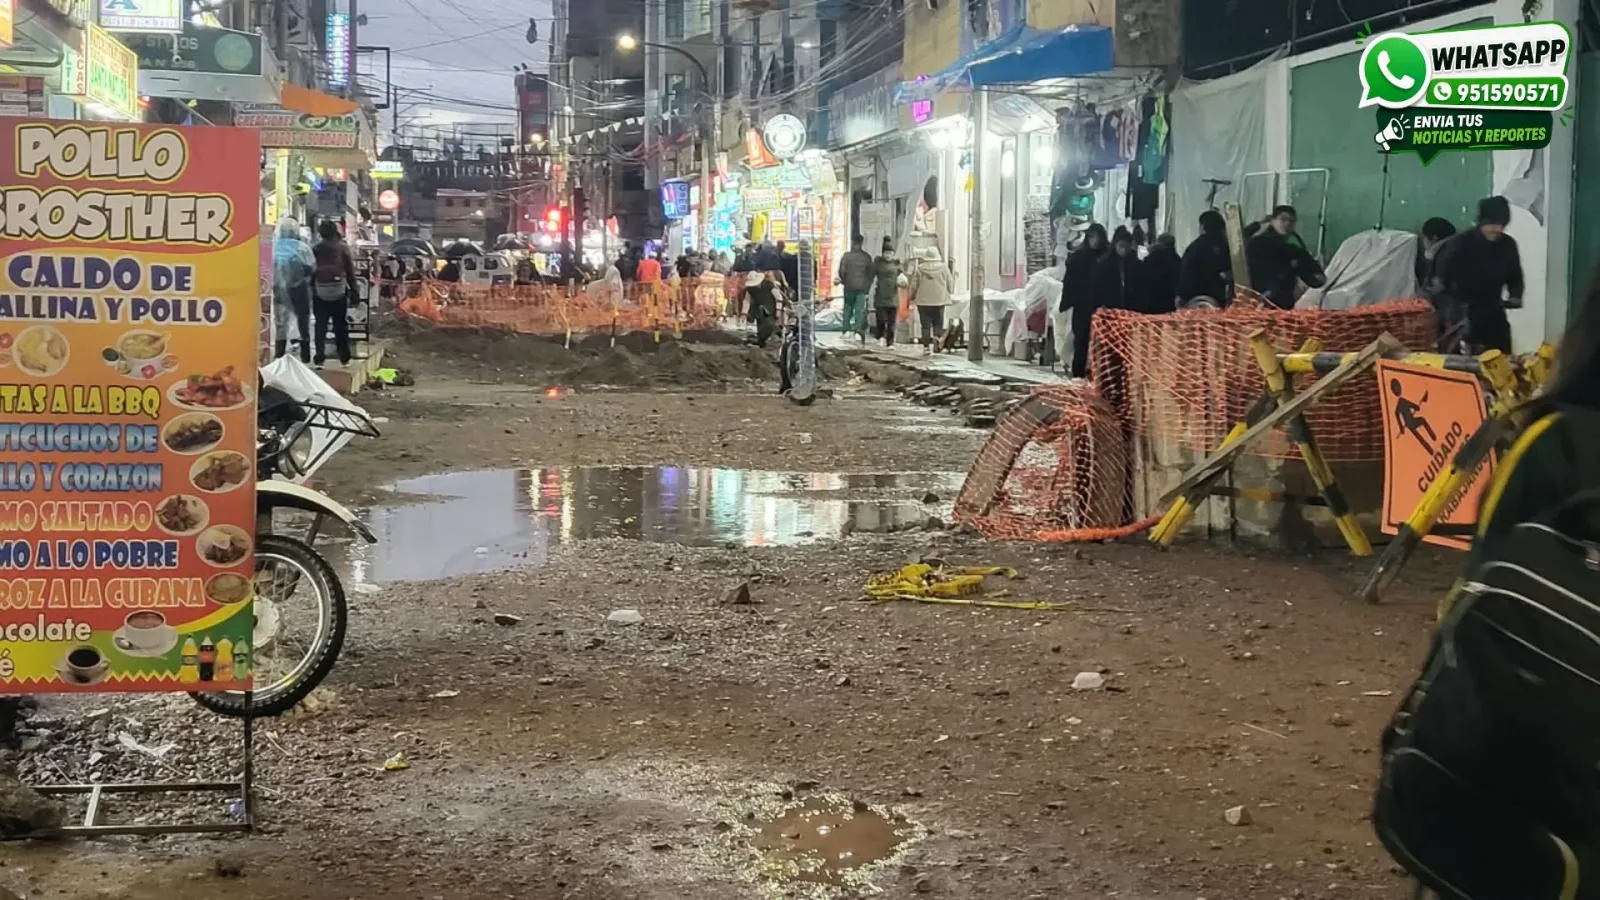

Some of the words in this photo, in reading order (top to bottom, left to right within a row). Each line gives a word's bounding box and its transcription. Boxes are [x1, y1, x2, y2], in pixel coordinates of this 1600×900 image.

[18, 125, 186, 181] POLLO
[8, 255, 141, 290] CALDO
[151, 265, 192, 291] DE
[0, 294, 97, 320] ALLINA
[104, 298, 124, 320] Y
[131, 299, 222, 323] POLLO
[0, 385, 47, 414] TAS
[51, 386, 69, 413] A
[73, 386, 104, 414] LA
[107, 387, 161, 418] BBQ
[0, 423, 121, 452] TICUCHOS
[126, 424, 159, 453] DE
[1417, 421, 1463, 494] CUIDADO
[0, 461, 36, 492] LLO
[41, 462, 57, 492] Y
[60, 463, 163, 492] CORAZON
[0, 500, 37, 531] MO
[40, 500, 153, 532] SALTADO
[0, 540, 30, 570] MO
[35, 539, 54, 570] A
[58, 540, 90, 570] LO
[93, 540, 179, 569] POBRE
[0, 579, 46, 609] ROZ
[49, 579, 67, 608] A
[71, 579, 103, 608] LA
[105, 578, 206, 607] CUBANA
[0, 649, 15, 677] é
